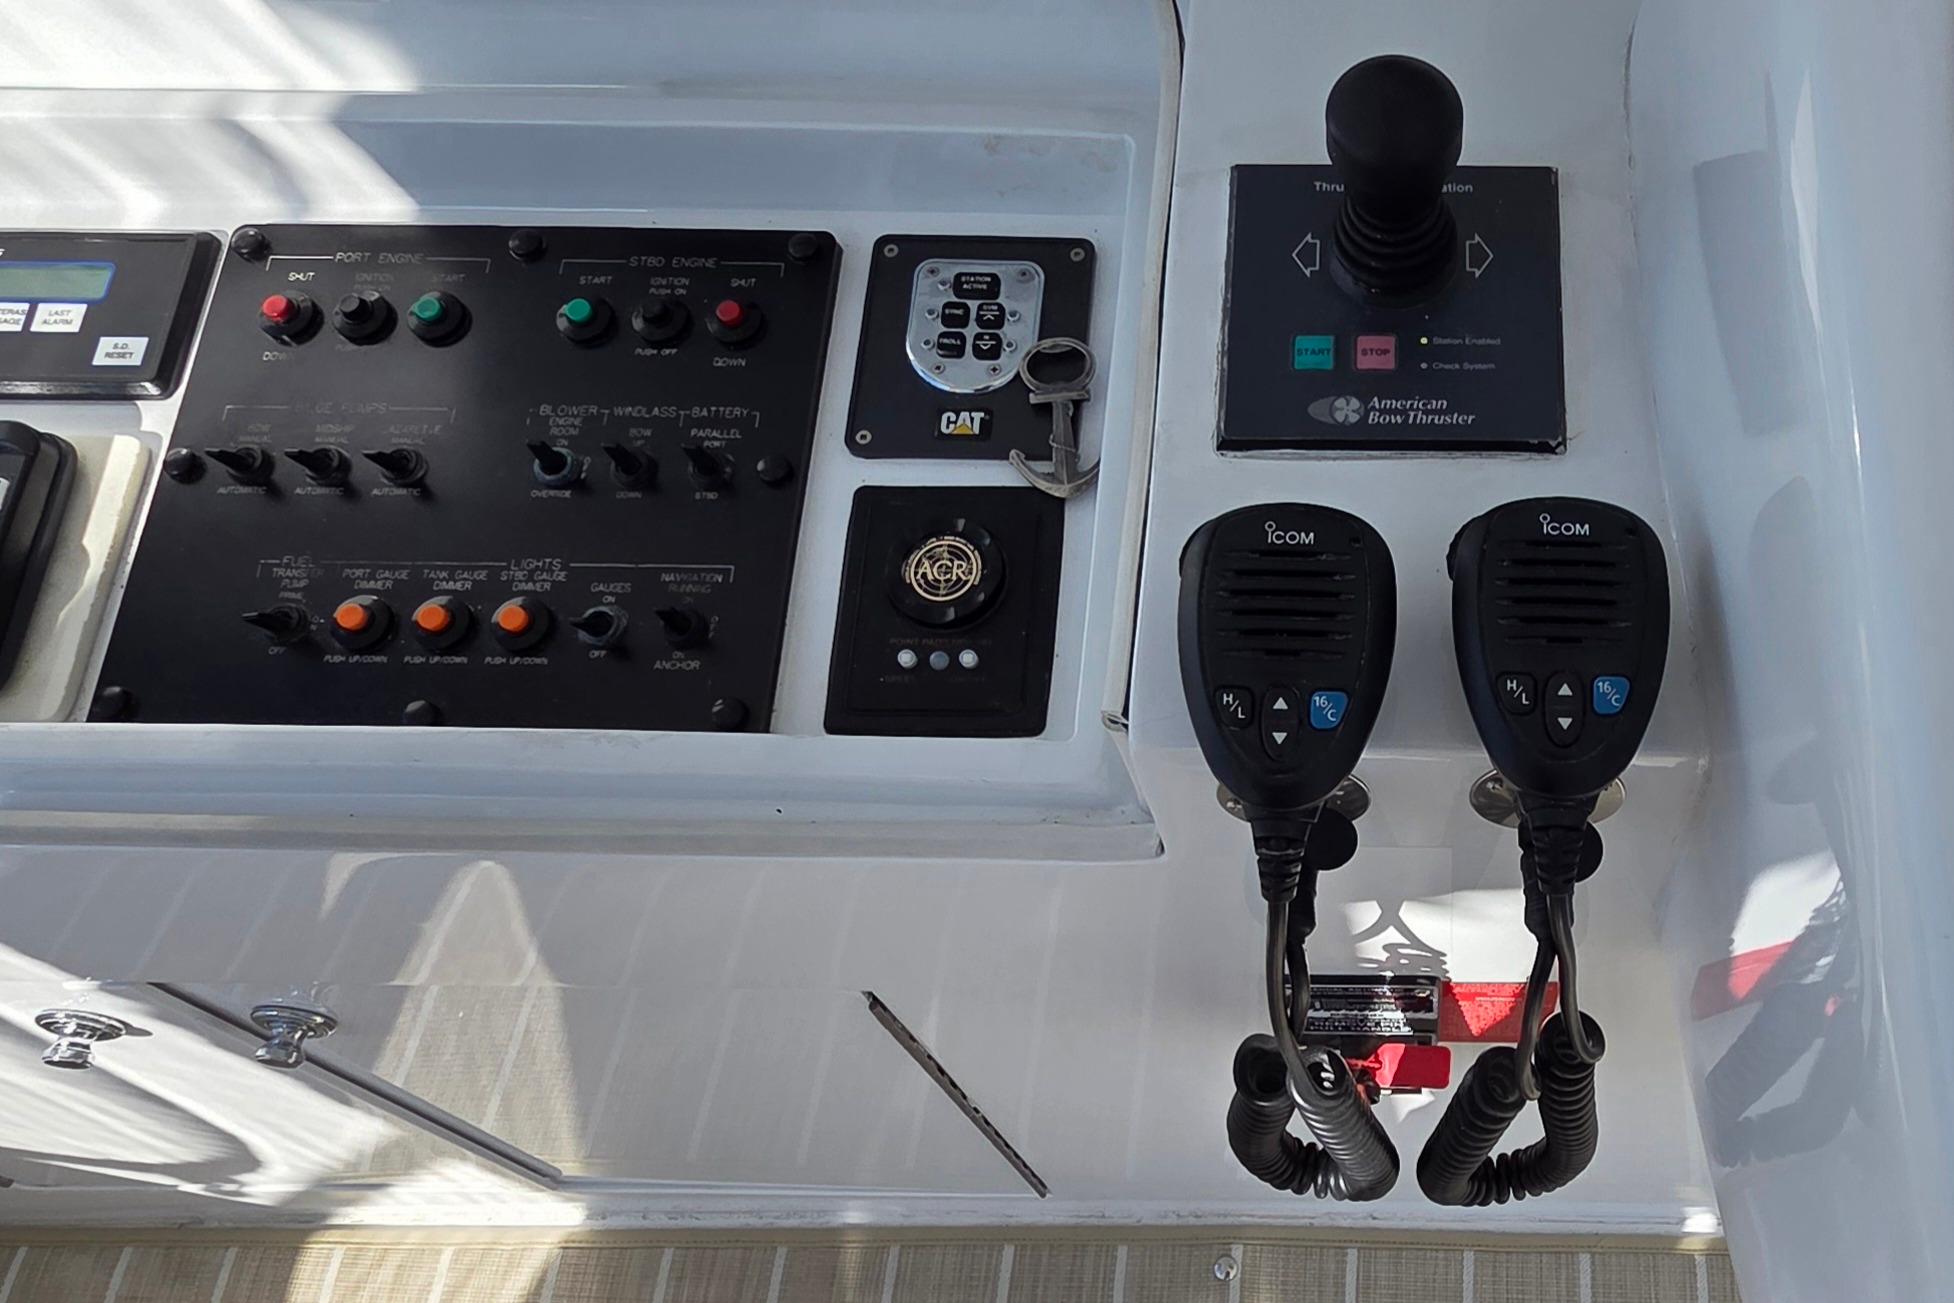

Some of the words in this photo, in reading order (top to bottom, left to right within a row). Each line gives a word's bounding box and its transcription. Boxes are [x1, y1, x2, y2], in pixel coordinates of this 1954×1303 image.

[334, 252, 371, 264] PORT
[377, 252, 424, 265] ENGINE
[629, 256, 665, 268] STBD
[672, 257, 718, 269] ENGINE
[287, 271, 316, 282] SHUT
[579, 275, 613, 286] START
[650, 277, 690, 287] IGNITION
[960, 275, 992, 283] STATION
[730, 278, 757, 288] SHUT
[48, 309, 72, 317] LAST
[42, 318, 74, 326] ALARM
[1432, 336, 1463, 346] Station
[1465, 336, 1501, 346] Enabled
[104, 351, 134, 360] RESET
[1296, 348, 1332, 357] START
[1360, 348, 1391, 357] STOP
[712, 356, 747, 368] DOWN
[1432, 361, 1460, 370] Check
[1463, 362, 1496, 372] System
[1368, 396, 1448, 410] American
[538, 404, 599, 417] BLOWER
[613, 406, 678, 418] WINDLASS
[691, 407, 750, 419] BATTERY
[549, 417, 583, 427] ENGINE
[940, 411, 985, 435] CAT
[1368, 411, 1405, 425] Bow
[1407, 411, 1476, 425] Thruster
[550, 427, 580, 436] ROOM
[690, 428, 742, 439] PARALLEL
[217, 486, 268, 495] AUTOMATIC
[294, 486, 345, 496] AUTOMATIC
[371, 487, 422, 496] AUTOMATIC
[281, 556, 316, 568] FUEL
[510, 558, 563, 571] LIGHTS
[342, 568, 372, 580] PORT
[375, 569, 411, 580] GAUGE
[422, 569, 451, 580] TANK
[454, 570, 489, 581] GAUGE
[500, 570, 530, 582] STBD
[533, 571, 569, 582] GAUGE
[916, 559, 972, 582] ACR
[280, 578, 310, 589] PUMP
[660, 572, 724, 584] NAVIGATION
[353, 580, 394, 590] DIMMER
[432, 580, 473, 591] DIMMER
[511, 581, 552, 592] DIMMER
[590, 582, 632, 593] GAUGES
[653, 659, 701, 671] ANCHOR
[1597, 681, 1620, 707] 16/C
[1313, 696, 1337, 722] 16/C
